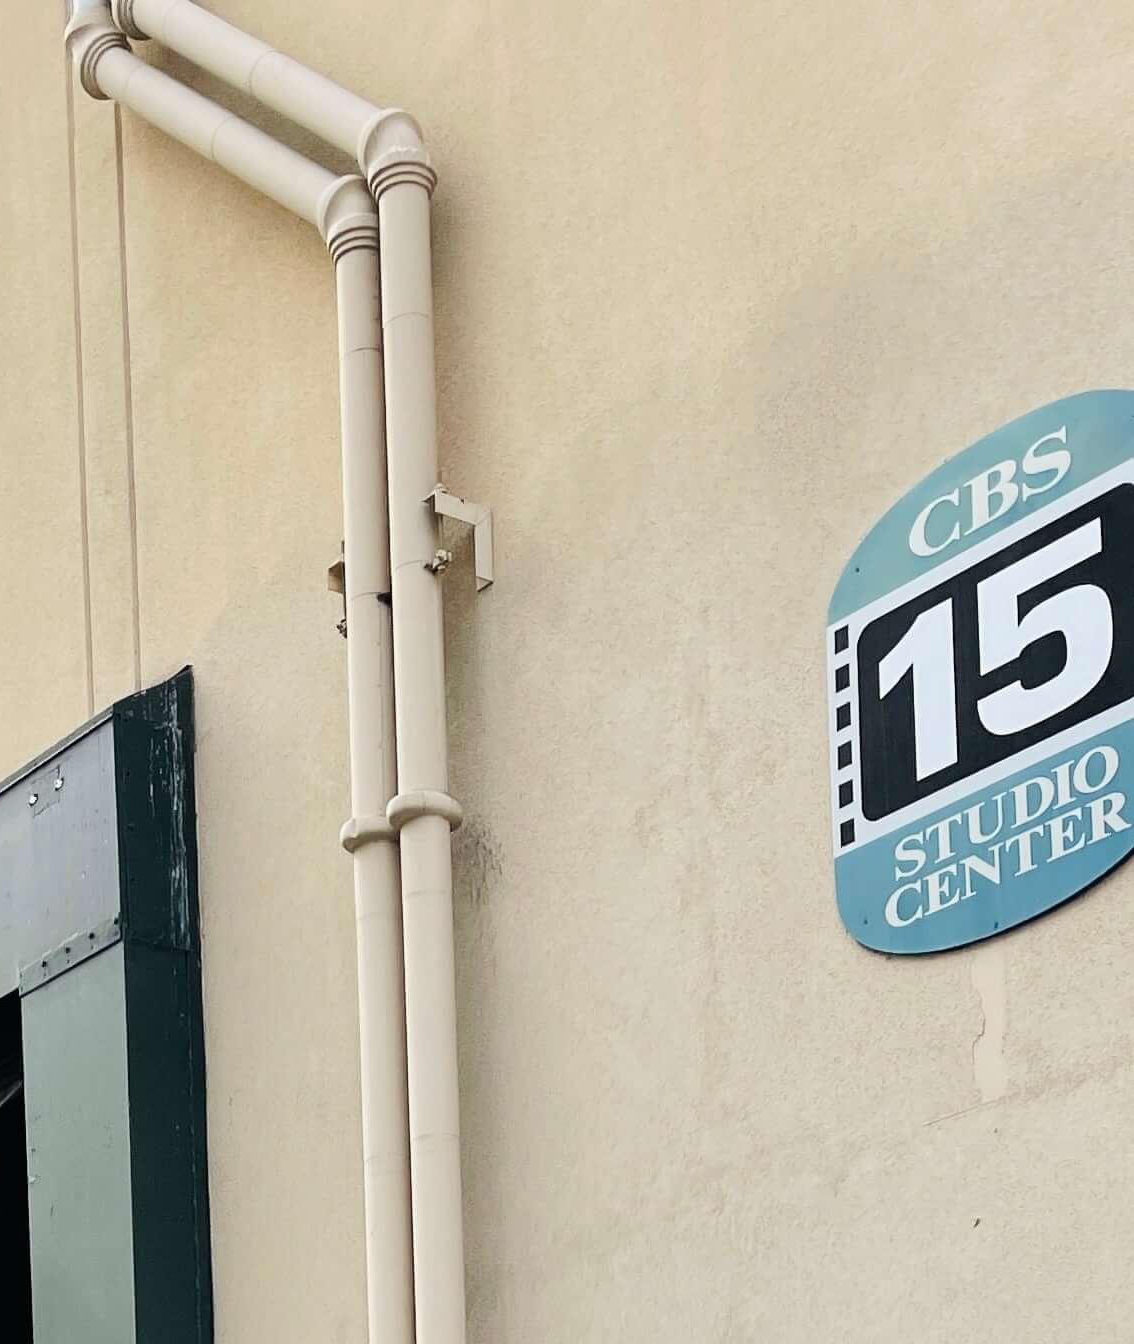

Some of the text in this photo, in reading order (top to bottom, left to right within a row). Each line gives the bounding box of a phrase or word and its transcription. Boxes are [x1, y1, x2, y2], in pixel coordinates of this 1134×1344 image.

[908, 425, 1072, 558] CBS
[878, 516, 1113, 782] 15
[884, 791, 1132, 928] CENTER
[894, 744, 1120, 881] STUDIO
